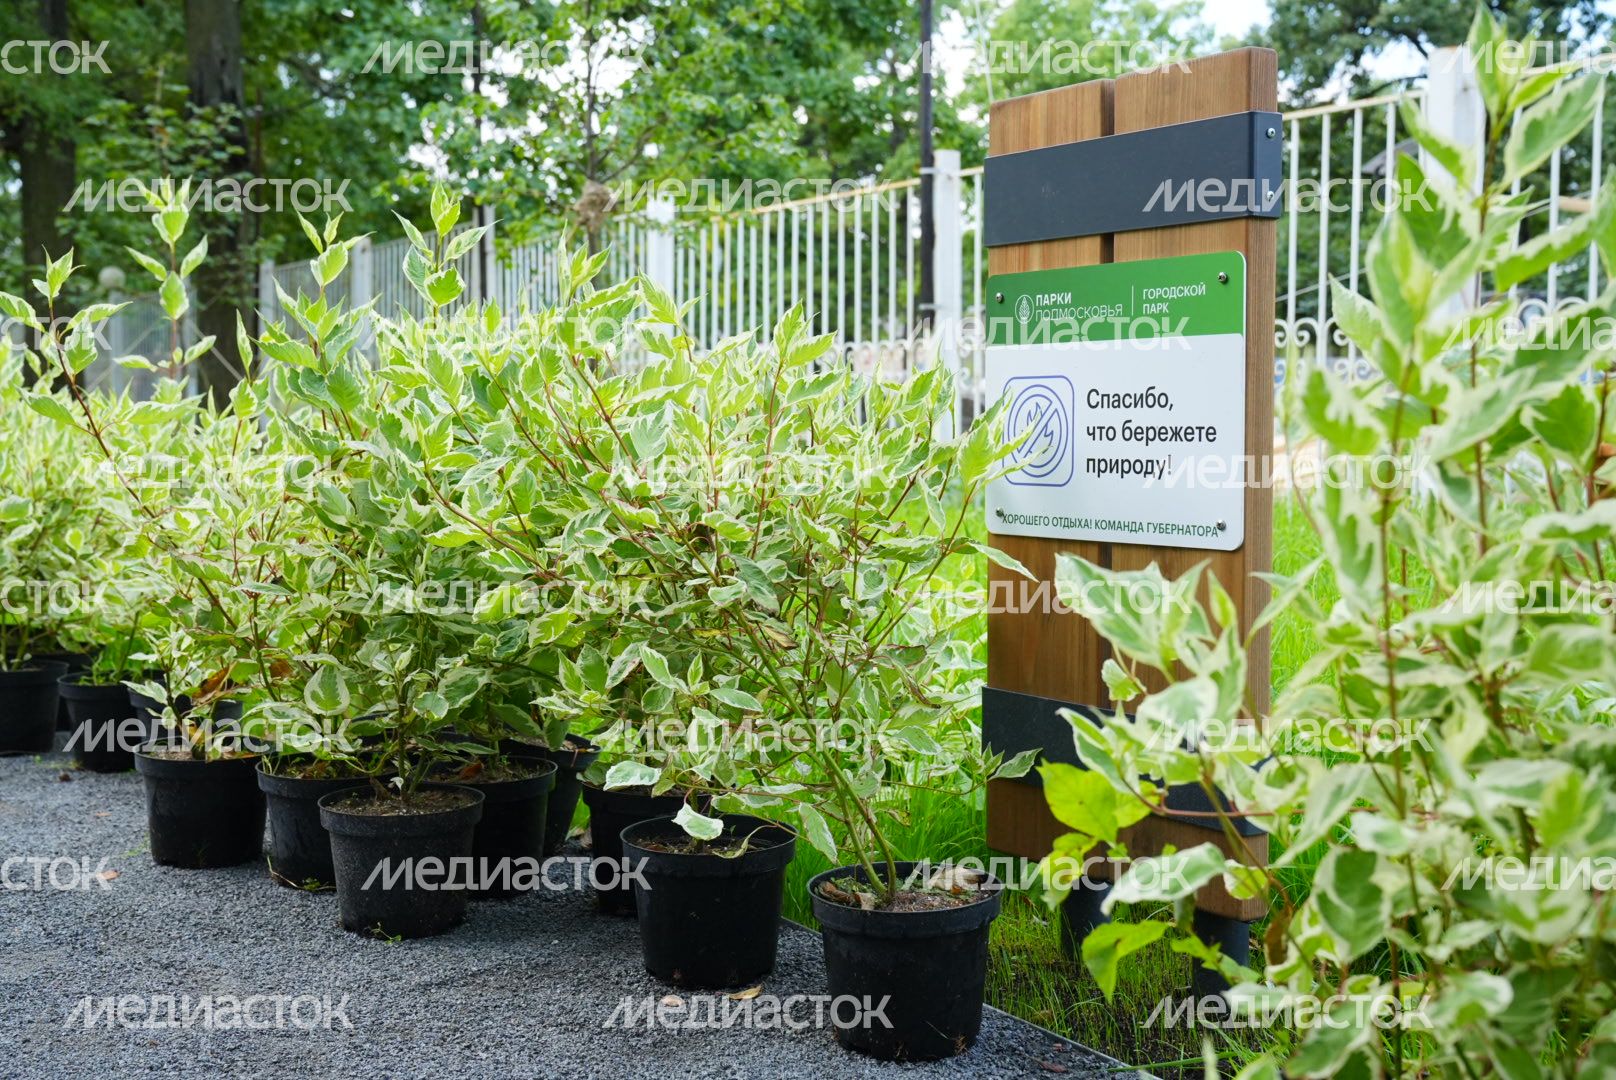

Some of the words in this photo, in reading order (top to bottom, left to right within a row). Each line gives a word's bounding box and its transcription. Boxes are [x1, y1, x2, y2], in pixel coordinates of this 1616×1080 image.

[1035, 292, 1072, 307] ПАРКИ
[1142, 282, 1206, 300] ГОРОДСКОЙ
[1035, 303, 1123, 322] ПОДМОСКОВЬЯ
[1142, 302, 1169, 315] ПАРК
[1086, 386, 1174, 411] Спасибо,
[1086, 425, 1117, 442] что
[1121, 419, 1217, 447] бережете
[1086, 454, 1172, 481] природу!
[1002, 513, 1050, 527] ХОРОШЕГО
[1051, 516, 1093, 530] ОТДЫХА!
[1094, 519, 1144, 533] КОМАНДА
[1146, 522, 1219, 538] ГУБЕРНАТОРА
